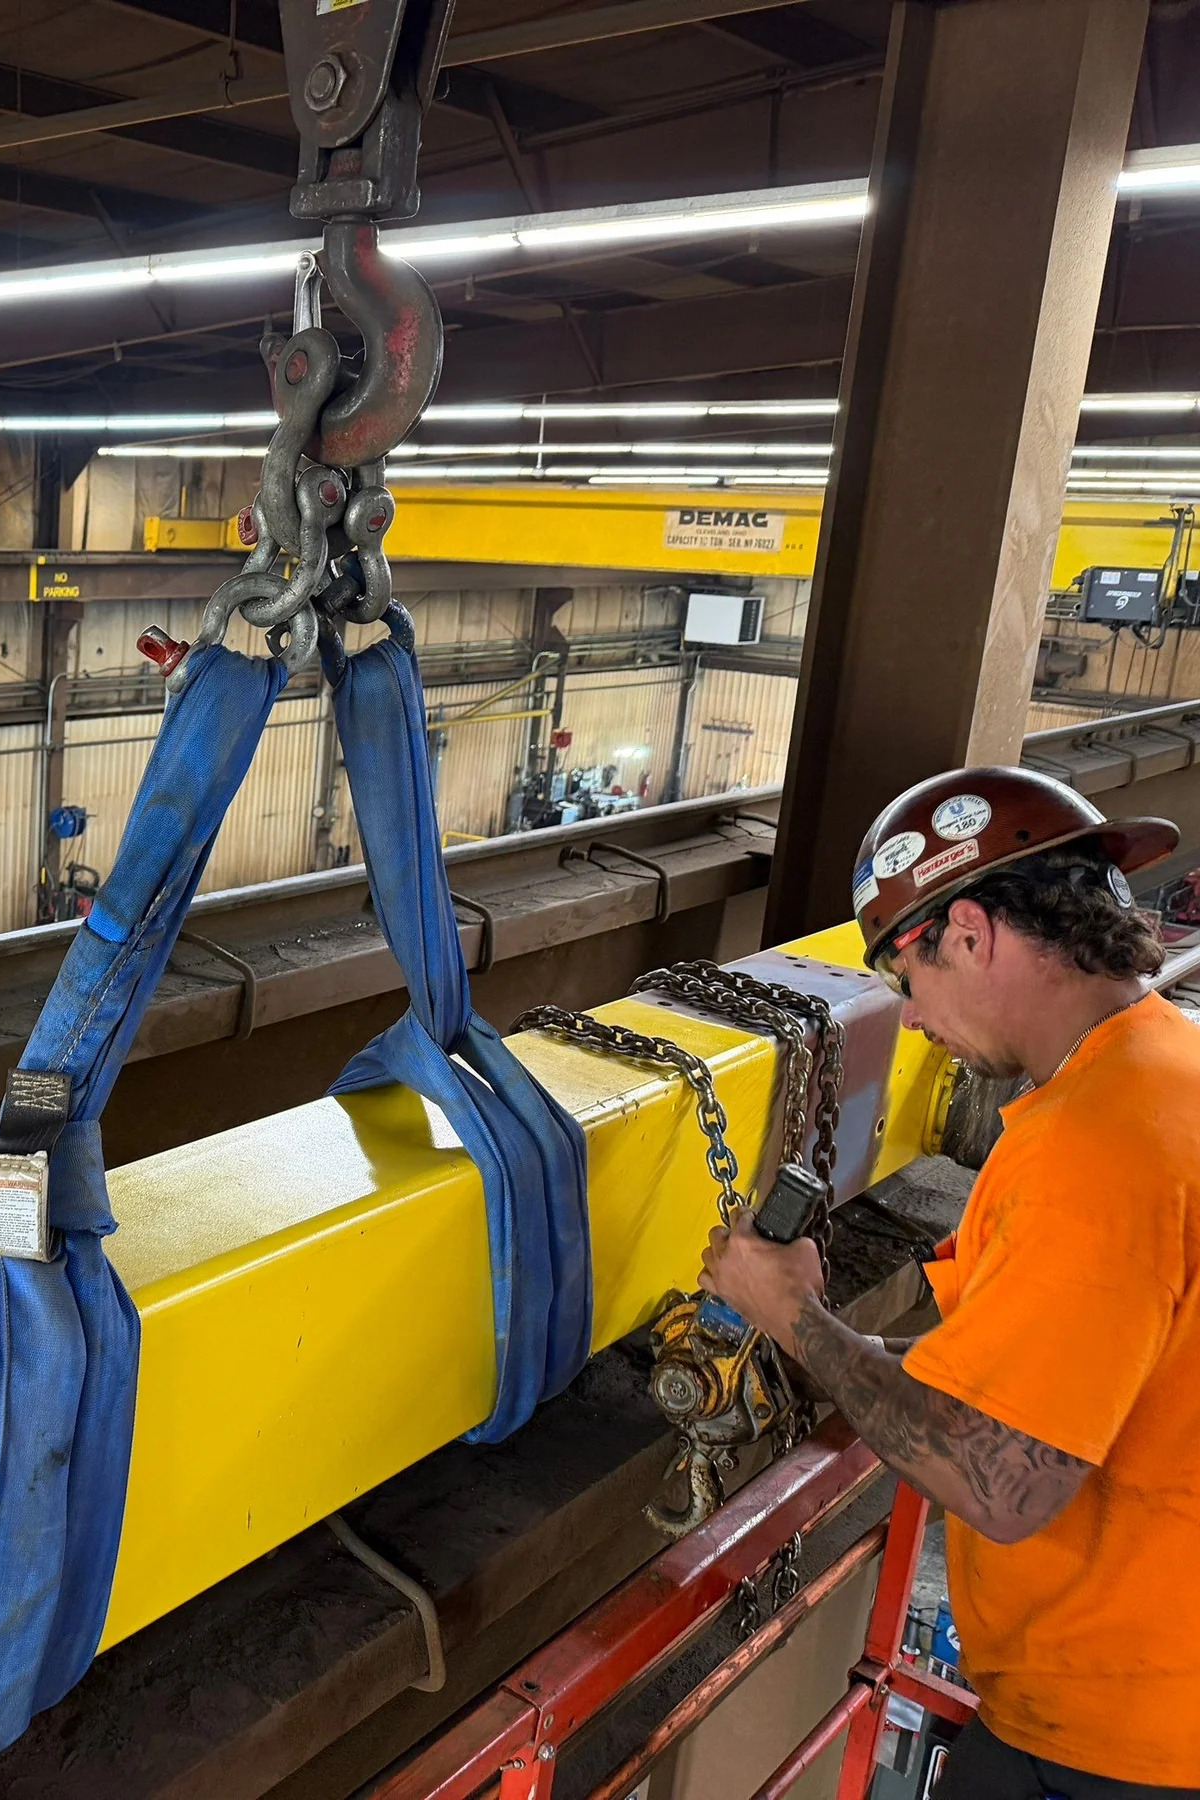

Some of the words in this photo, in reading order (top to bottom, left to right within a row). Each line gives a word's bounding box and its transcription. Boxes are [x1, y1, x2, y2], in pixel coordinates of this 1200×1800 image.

[679, 510, 769, 528] DEMAG
[667, 535, 698, 545] CAPACITY
[710, 537, 723, 547] TON
[54, 572, 68, 583] NO
[43, 586, 80, 598] PARKING
